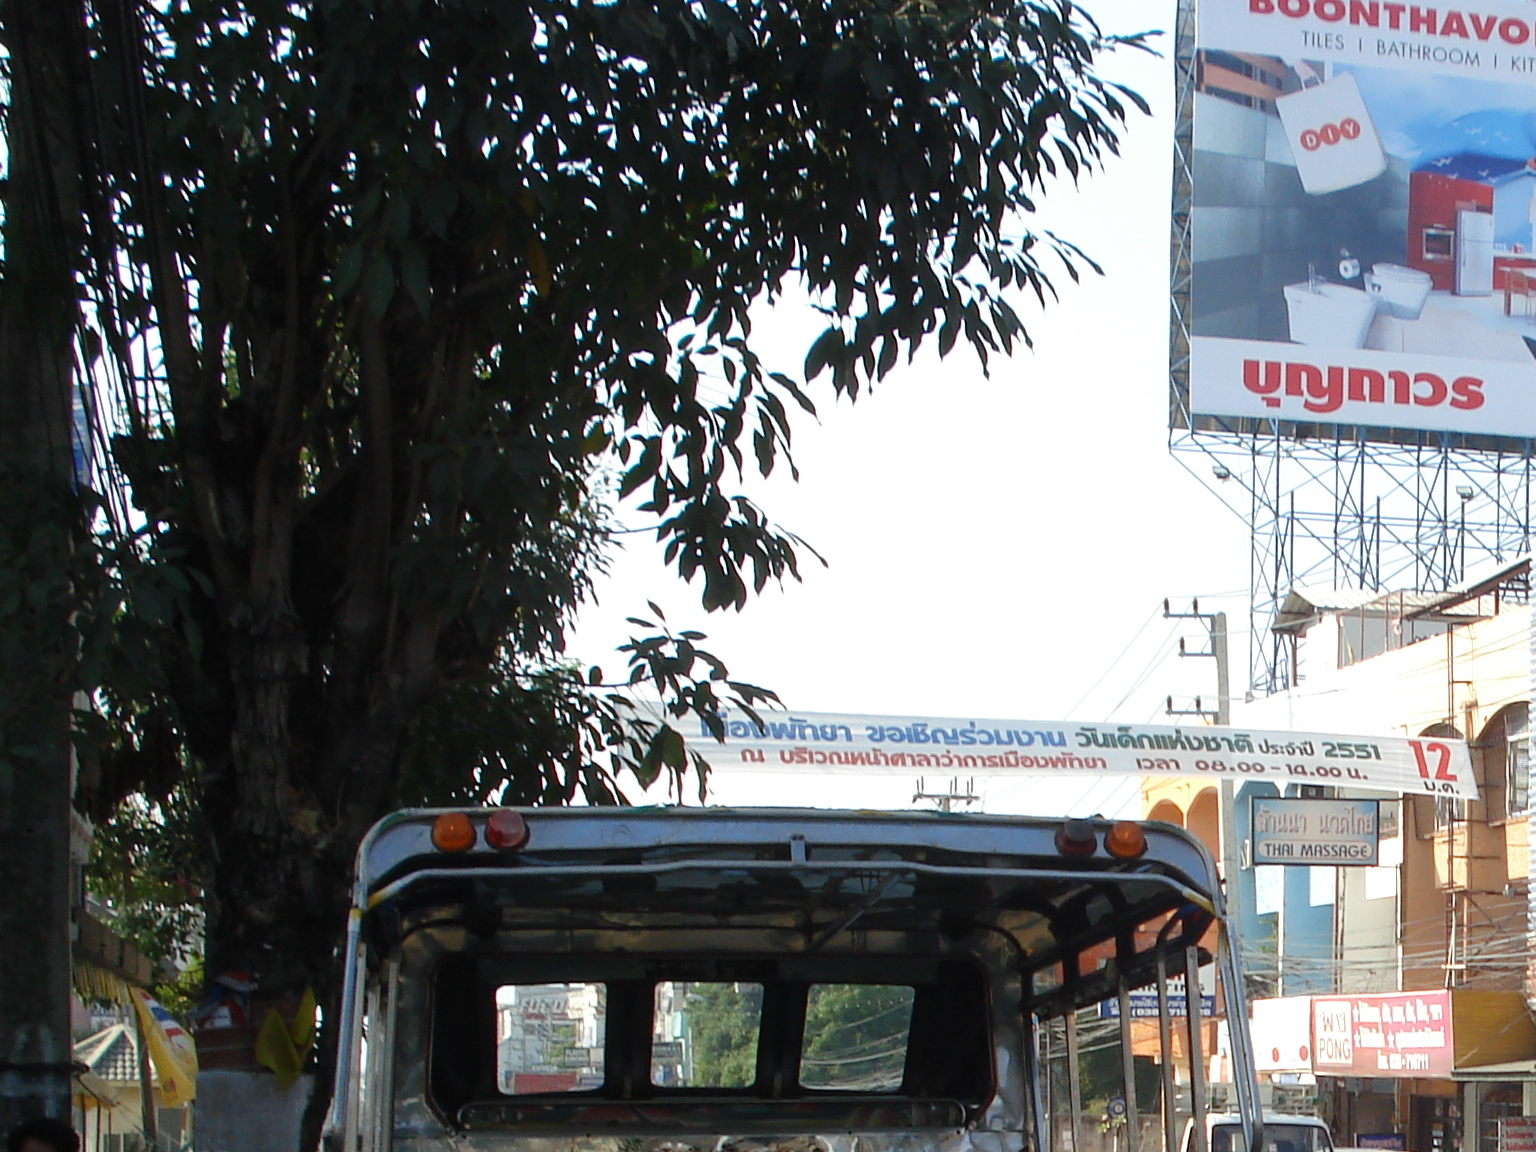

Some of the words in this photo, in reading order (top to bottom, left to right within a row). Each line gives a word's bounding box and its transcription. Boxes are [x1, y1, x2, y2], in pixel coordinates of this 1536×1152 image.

[1301, 30, 1345, 50] TILES
[1376, 38, 1481, 67] BATHROOM
[1301, 117, 1360, 151] DIY
[1243, 358, 1485, 413] บุญถาวร
[866, 720, 1066, 748] ขอเชิญร่วมงาน
[1074, 726, 1255, 754] วันเด็กแห่งชาติ
[1258, 739, 1315, 758] ประจำปี
[1322, 741, 1382, 760] 2551
[741, 747, 765, 763] ณ
[1136, 757, 1181, 771] เวลา
[1195, 759, 1265, 773] 08.00
[1285, 762, 1342, 779] 14.00
[1347, 768, 1369, 780] น.
[1407, 739, 1459, 783] 12
[1423, 781, 1461, 795] ม.ค.
[1264, 842, 1294, 857] THAI
[1300, 843, 1368, 857] MASSAGE
[1319, 1038, 1351, 1061] PONG
